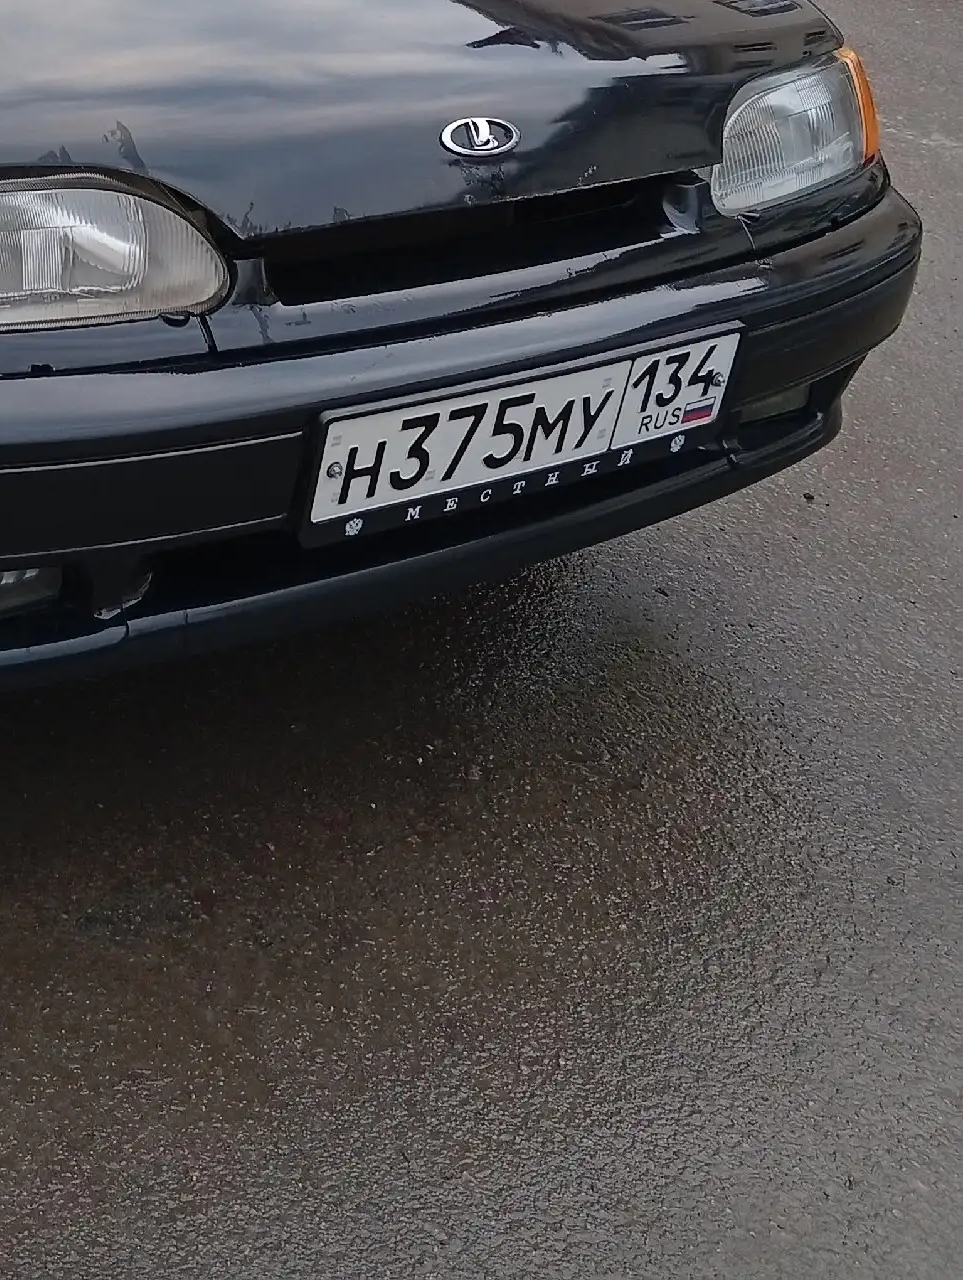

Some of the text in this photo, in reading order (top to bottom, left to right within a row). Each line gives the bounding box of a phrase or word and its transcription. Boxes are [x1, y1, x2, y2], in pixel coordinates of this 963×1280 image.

[338, 344, 718, 505] Н375МУ 134
[638, 407, 682, 434] RUS
